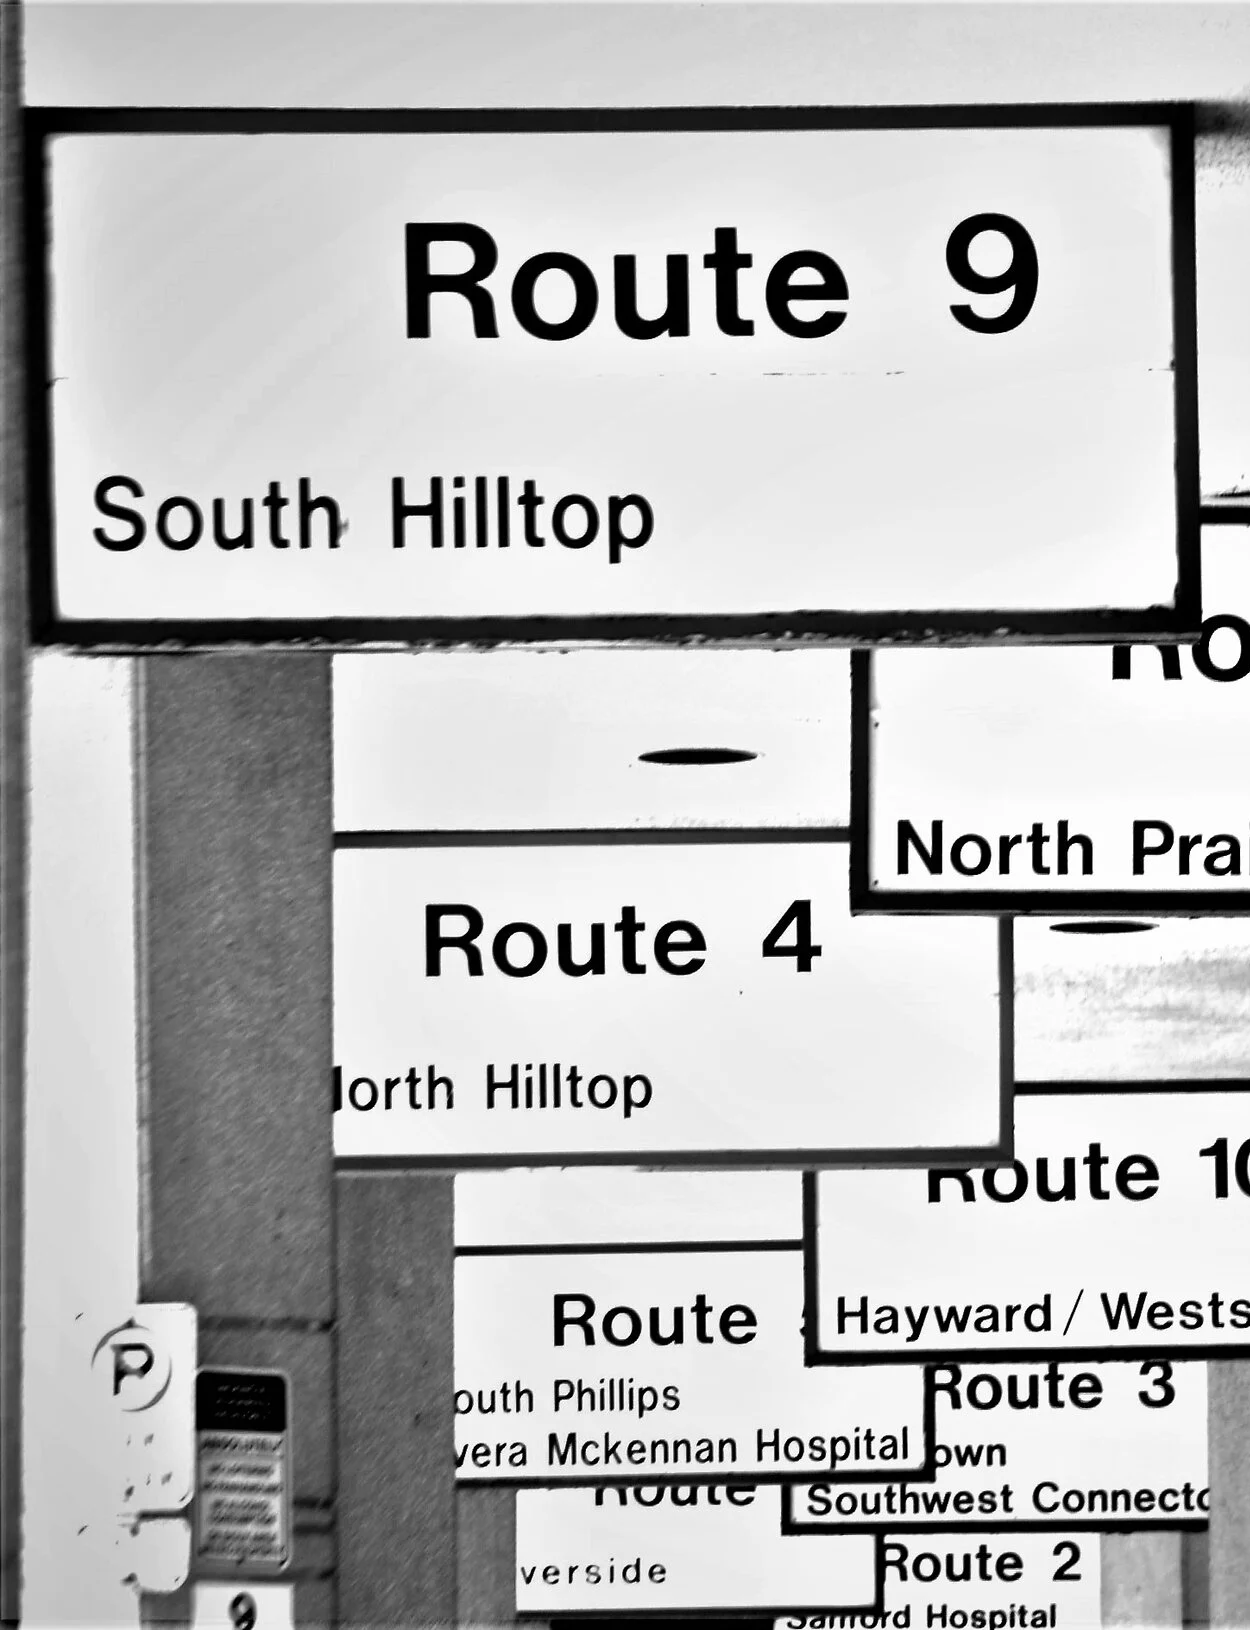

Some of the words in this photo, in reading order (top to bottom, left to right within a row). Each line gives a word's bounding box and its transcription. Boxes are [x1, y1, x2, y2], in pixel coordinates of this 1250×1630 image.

[405, 222, 849, 342] Route
[945, 212, 1039, 334] 9
[93, 475, 341, 552] South
[391, 475, 654, 564] Hilltop
[897, 819, 1094, 876] North
[425, 903, 707, 977] Route
[762, 899, 822, 972] 4
[333, 1064, 454, 1112] orth
[486, 1063, 653, 1118] Hilltop
[553, 1293, 758, 1346] Route
[553, 1378, 681, 1418] Phillips
[931, 1364, 1103, 1411] Route
[1138, 1361, 1176, 1409] 3
[548, 1431, 737, 1466] Mckennan
[756, 1425, 909, 1471] Hospital
[807, 1484, 1014, 1516] Southwest
[882, 1543, 1024, 1583] Route
[1052, 1540, 1082, 1581] 2
[926, 1603, 1056, 1630] Hospital
